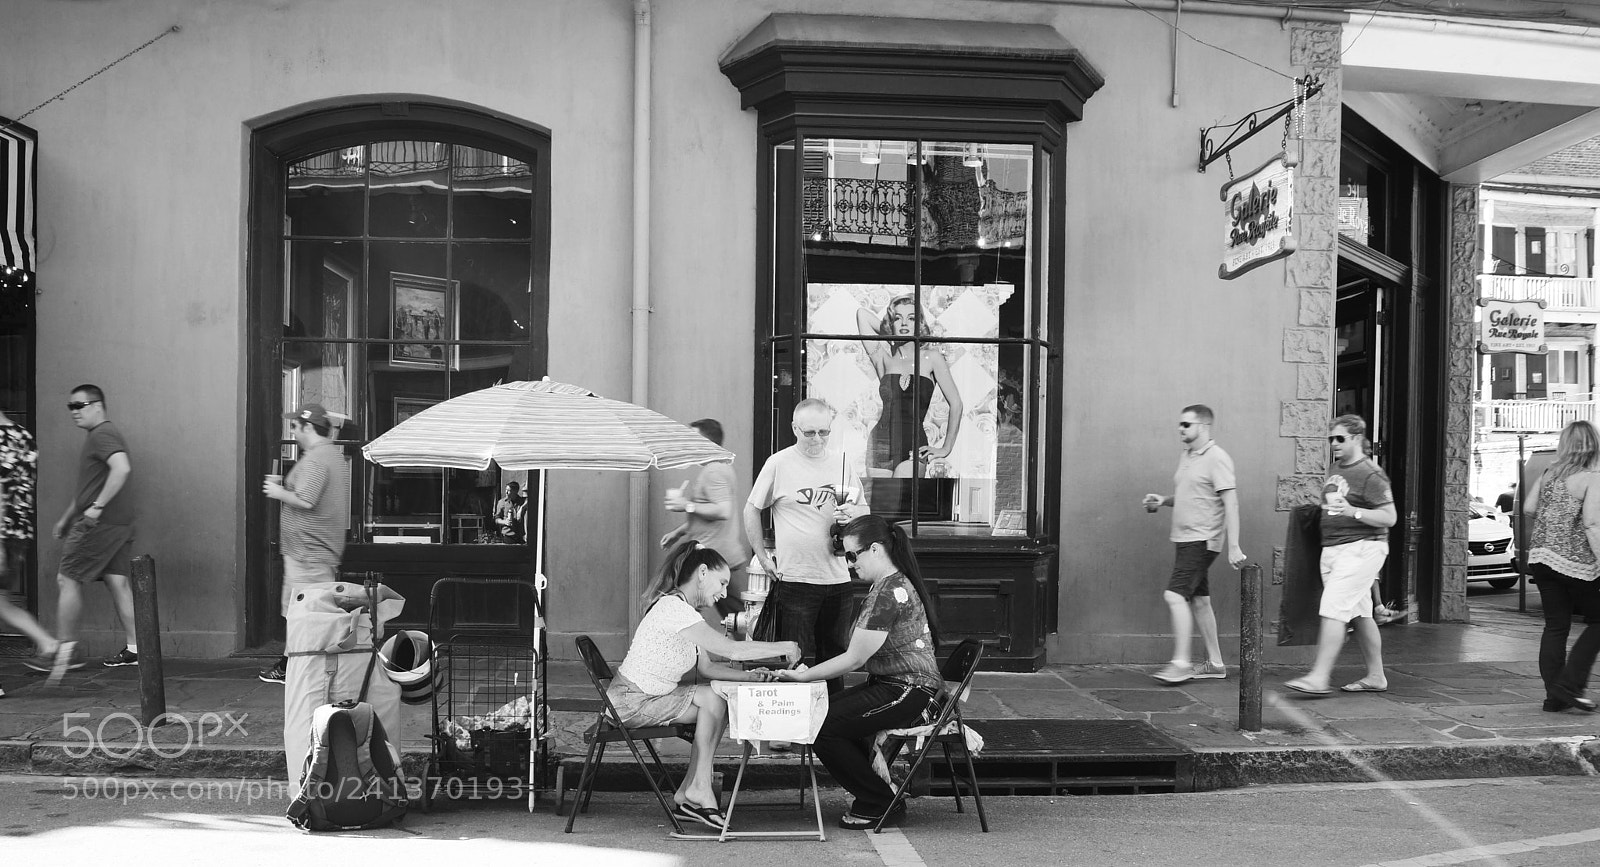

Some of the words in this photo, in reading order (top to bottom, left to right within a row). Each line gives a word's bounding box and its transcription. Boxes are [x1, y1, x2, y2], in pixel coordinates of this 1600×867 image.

[1230, 180, 1278, 227] Galerie
[1230, 228, 1249, 248] Rue
[1248, 211, 1279, 240] Royale
[1489, 310, 1538, 327] Galerie
[1488, 328, 1507, 338] Rue
[1507, 328, 1539, 340] Royale
[748, 687, 778, 697] Tarot
[757, 700, 764, 708] &
[771, 699, 795, 707] Palm
[758, 708, 801, 716] Readings
